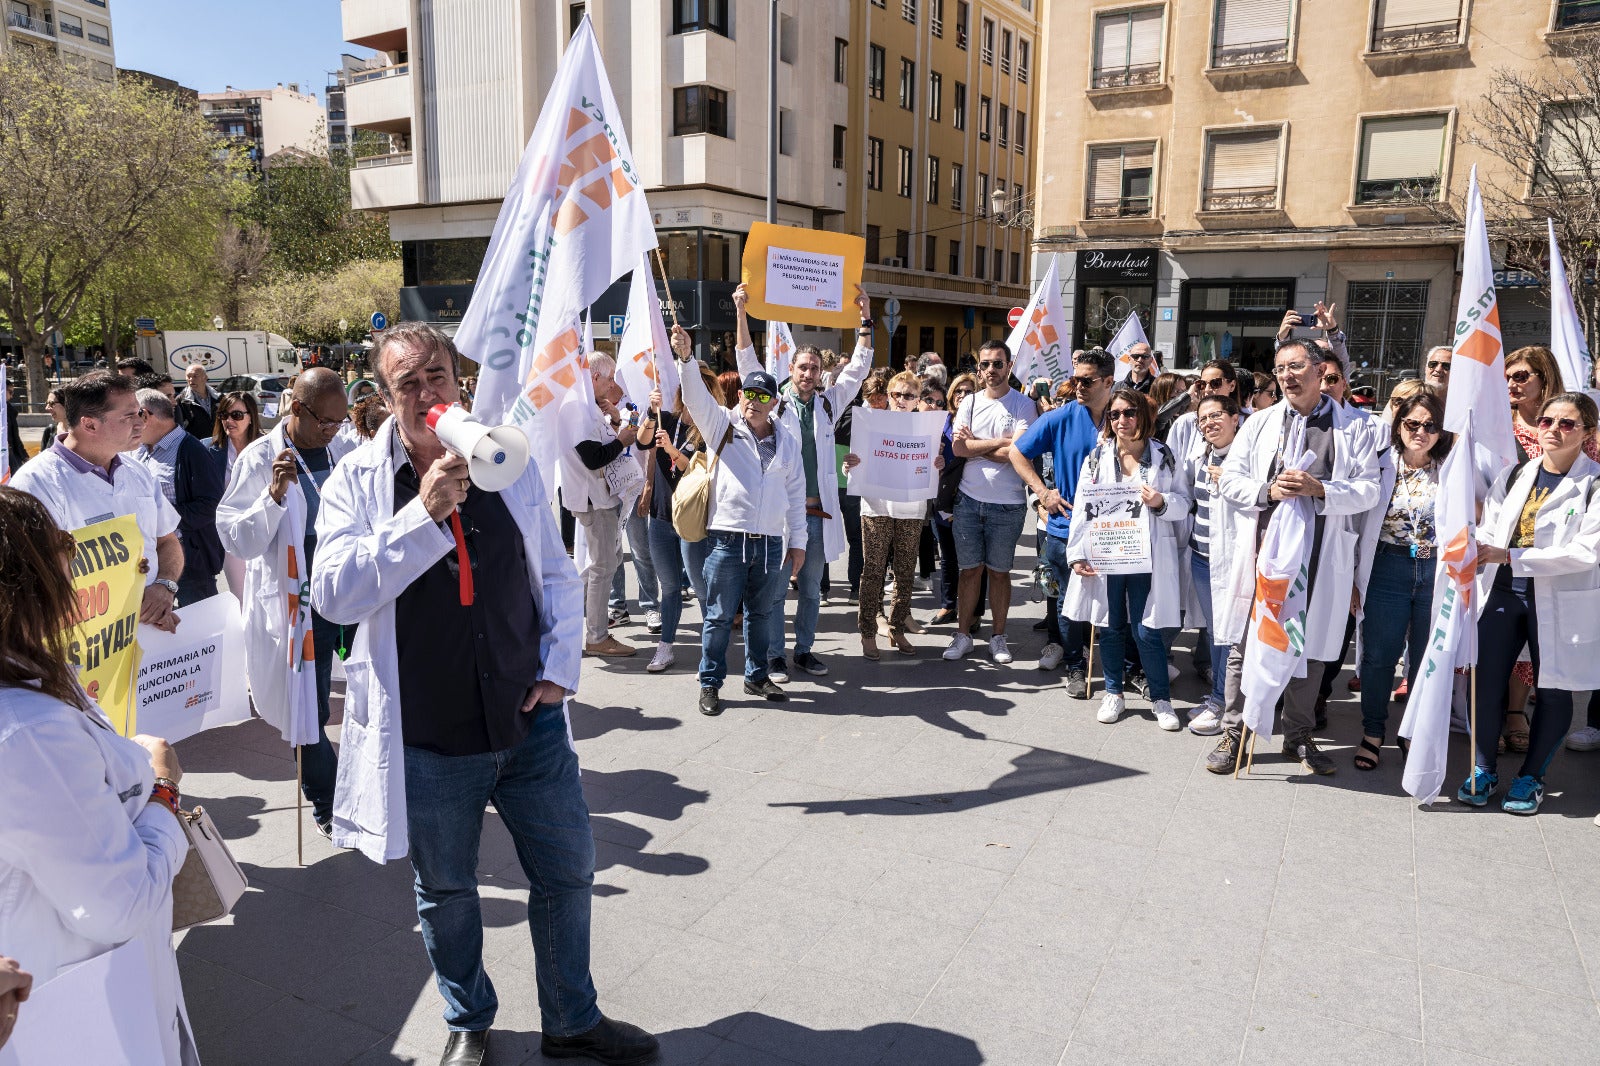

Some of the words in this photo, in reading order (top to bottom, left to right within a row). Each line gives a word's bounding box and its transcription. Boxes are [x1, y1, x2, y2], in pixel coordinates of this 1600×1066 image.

[792, 256, 820, 266] GUARDIAS
[1084, 251, 1150, 269] Bardasú
[772, 263, 821, 274] REGLAMENTARIAS
[782, 273, 805, 281] PELIGRO
[613, 317, 623, 334] P
[882, 439, 895, 447] NO
[874, 449, 899, 460] LISTAS
[1101, 521, 1111, 529] DE
[1113, 520, 1137, 528] ABRIL
[72, 531, 130, 578] NITAS
[150, 650, 200, 673] PRIMARIA
[201, 644, 216, 656] NO
[138, 669, 188, 694] FUNCIONA
[190, 664, 201, 675] LA
[142, 680, 196, 708] SANIDAD!!!
